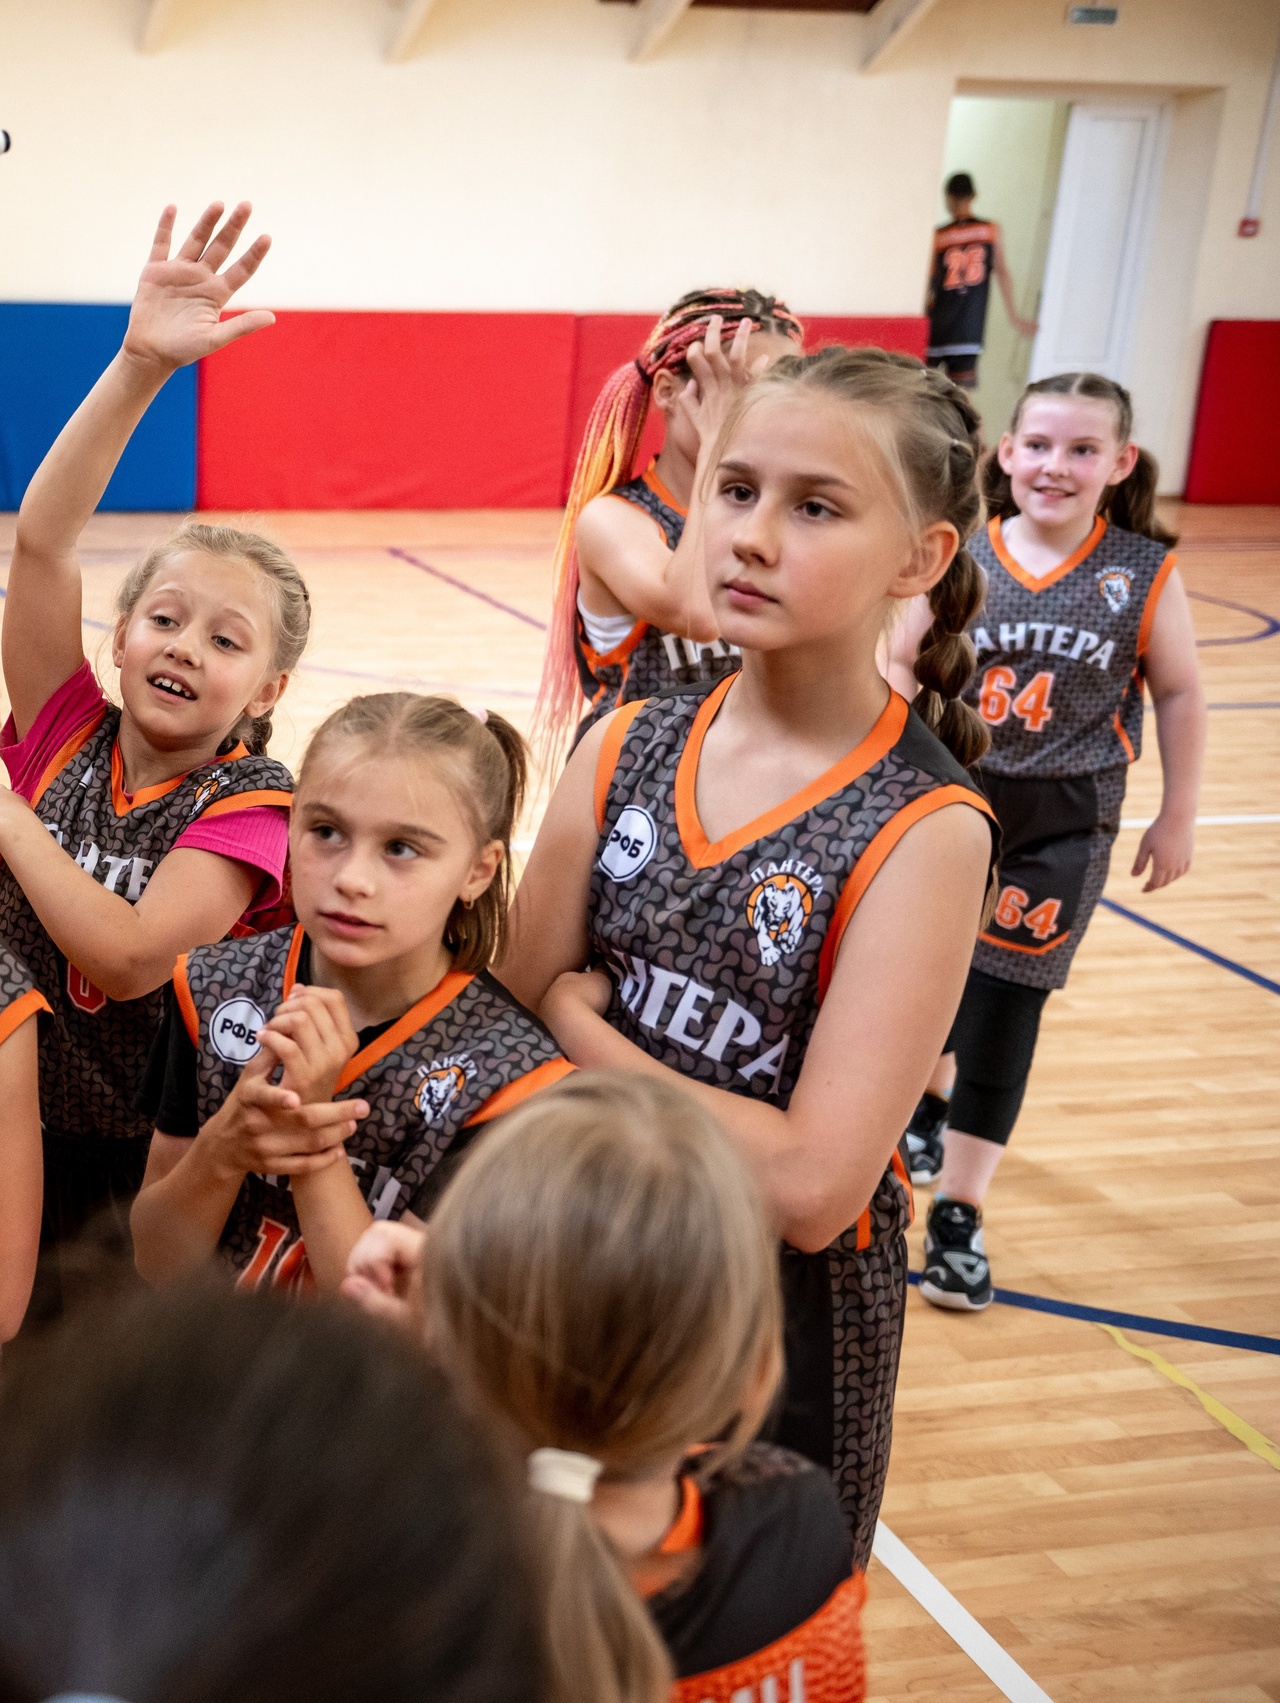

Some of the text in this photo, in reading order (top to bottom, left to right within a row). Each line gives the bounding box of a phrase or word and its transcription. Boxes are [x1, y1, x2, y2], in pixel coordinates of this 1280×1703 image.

[974, 622, 1116, 671] АНТЕРА
[979, 665, 1055, 733] 64
[750, 859, 824, 899] ПАНТЕРА
[994, 885, 1062, 940] 64
[220, 1017, 258, 1046] РФБ
[605, 948, 790, 1096] НТЕРА
